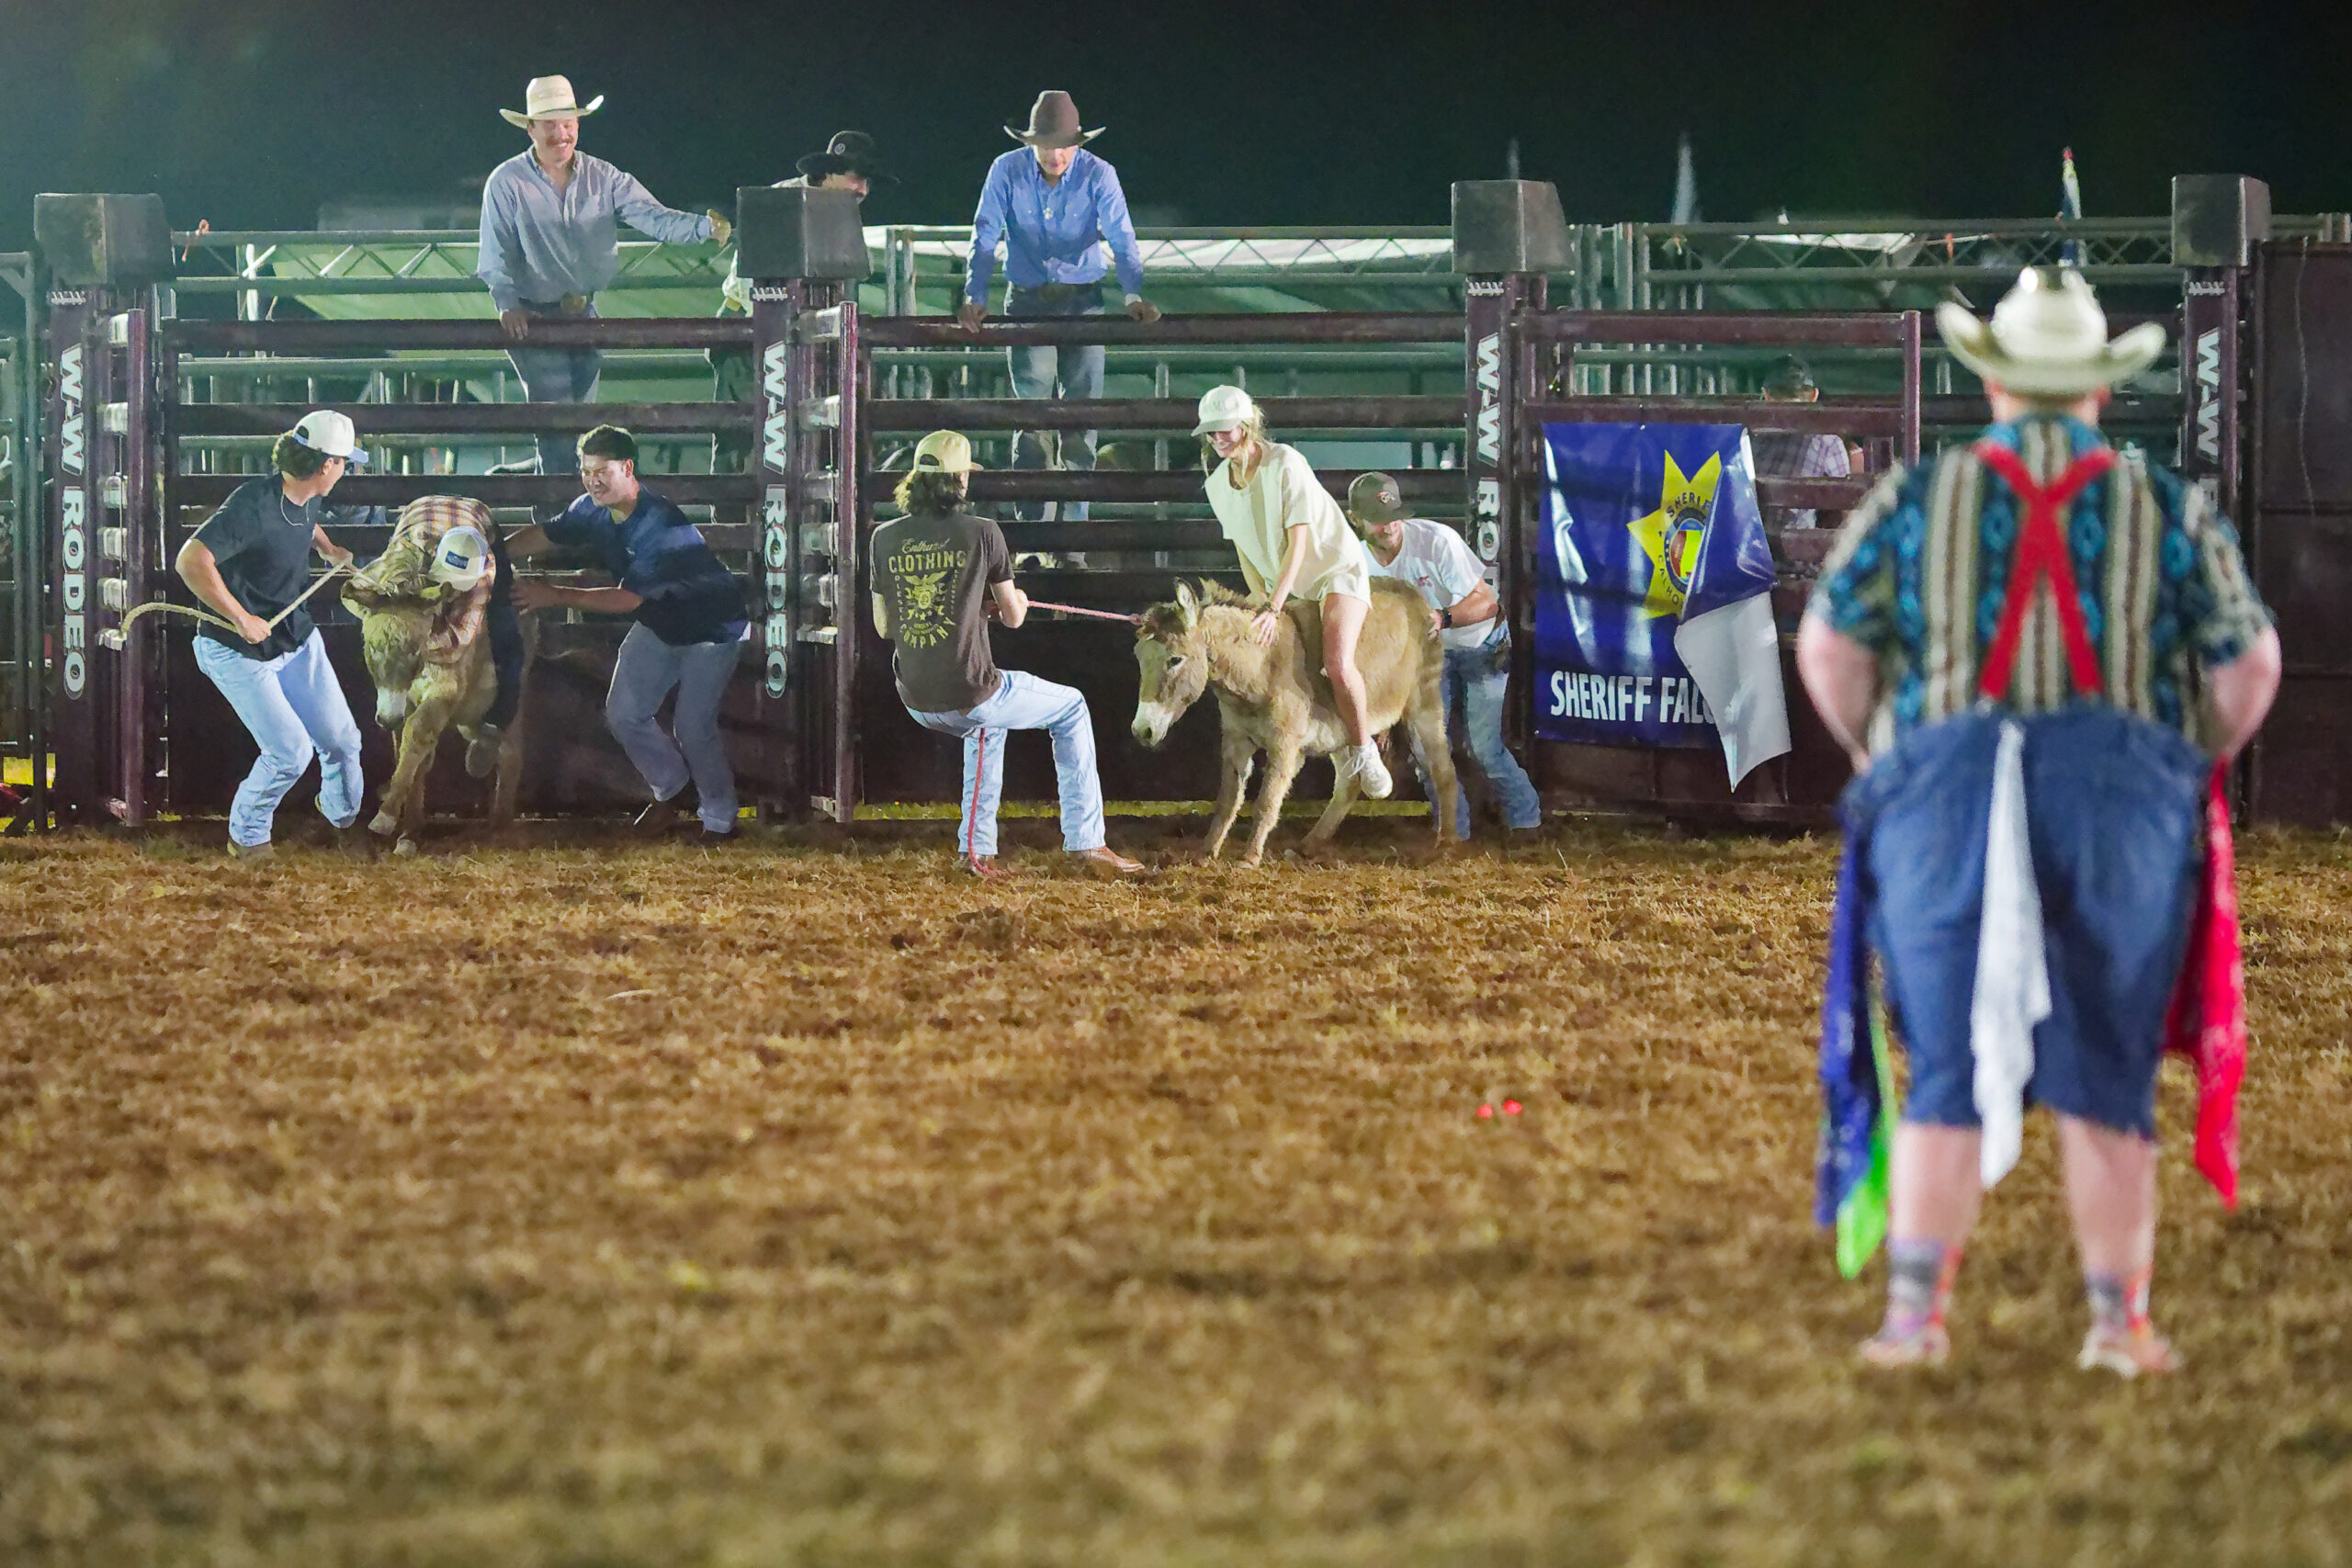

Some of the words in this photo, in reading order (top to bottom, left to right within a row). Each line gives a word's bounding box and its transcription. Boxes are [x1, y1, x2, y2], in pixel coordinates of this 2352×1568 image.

[61, 344, 85, 476] W-W
[764, 340, 787, 475] W-W
[1477, 332, 1500, 468] W-W
[2197, 326, 2221, 464] W-W
[62, 485, 85, 700] RODEO
[764, 483, 787, 698] RODEO
[888, 549, 967, 573] CLOTHING
[899, 616, 956, 649] COMPANY
[1550, 670, 1653, 723] SHERIFF
